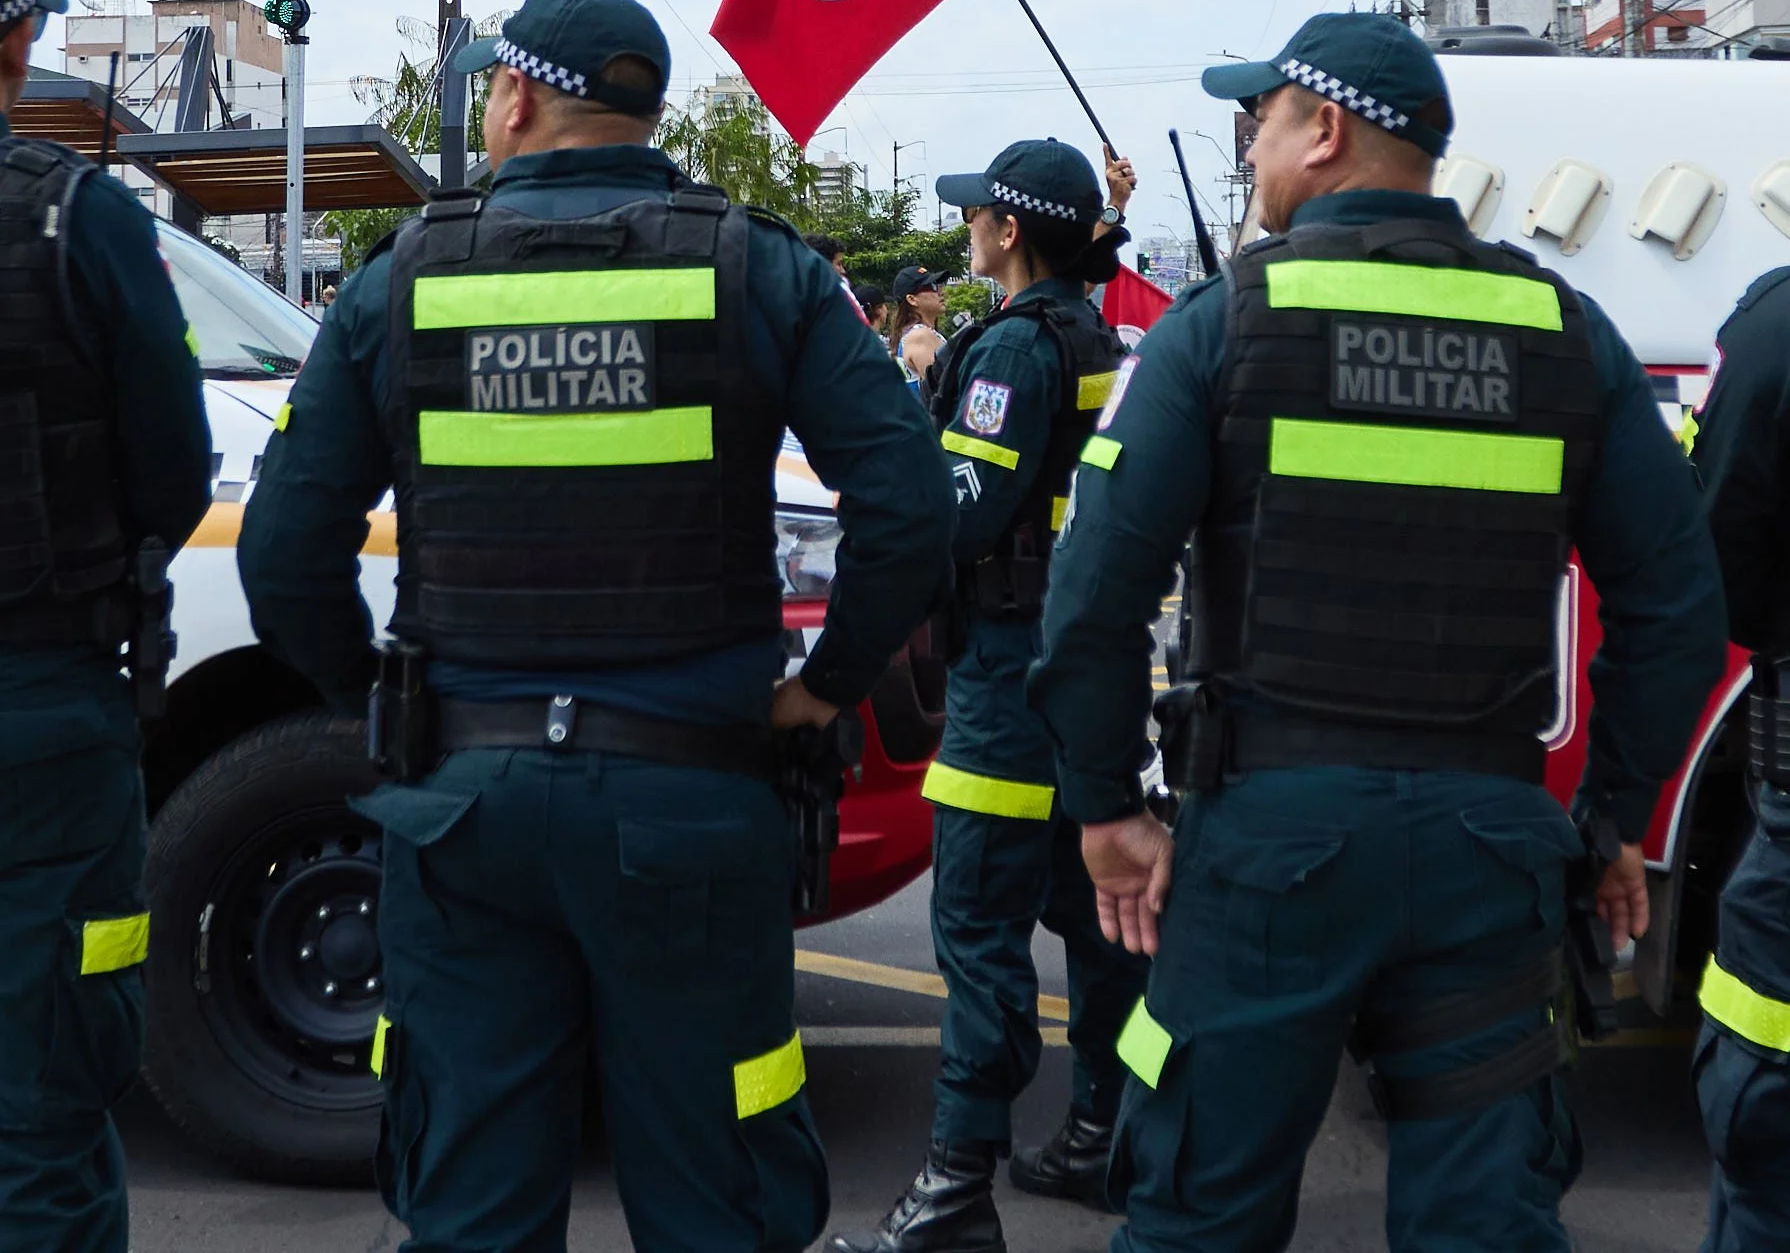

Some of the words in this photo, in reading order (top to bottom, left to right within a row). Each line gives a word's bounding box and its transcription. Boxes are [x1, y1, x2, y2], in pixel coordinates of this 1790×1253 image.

[470, 327, 645, 372] POLÍCIA
[1336, 325, 1510, 375] POLÍCIA
[470, 368, 648, 412] MILITAR
[1336, 364, 1511, 415] MILITAR
